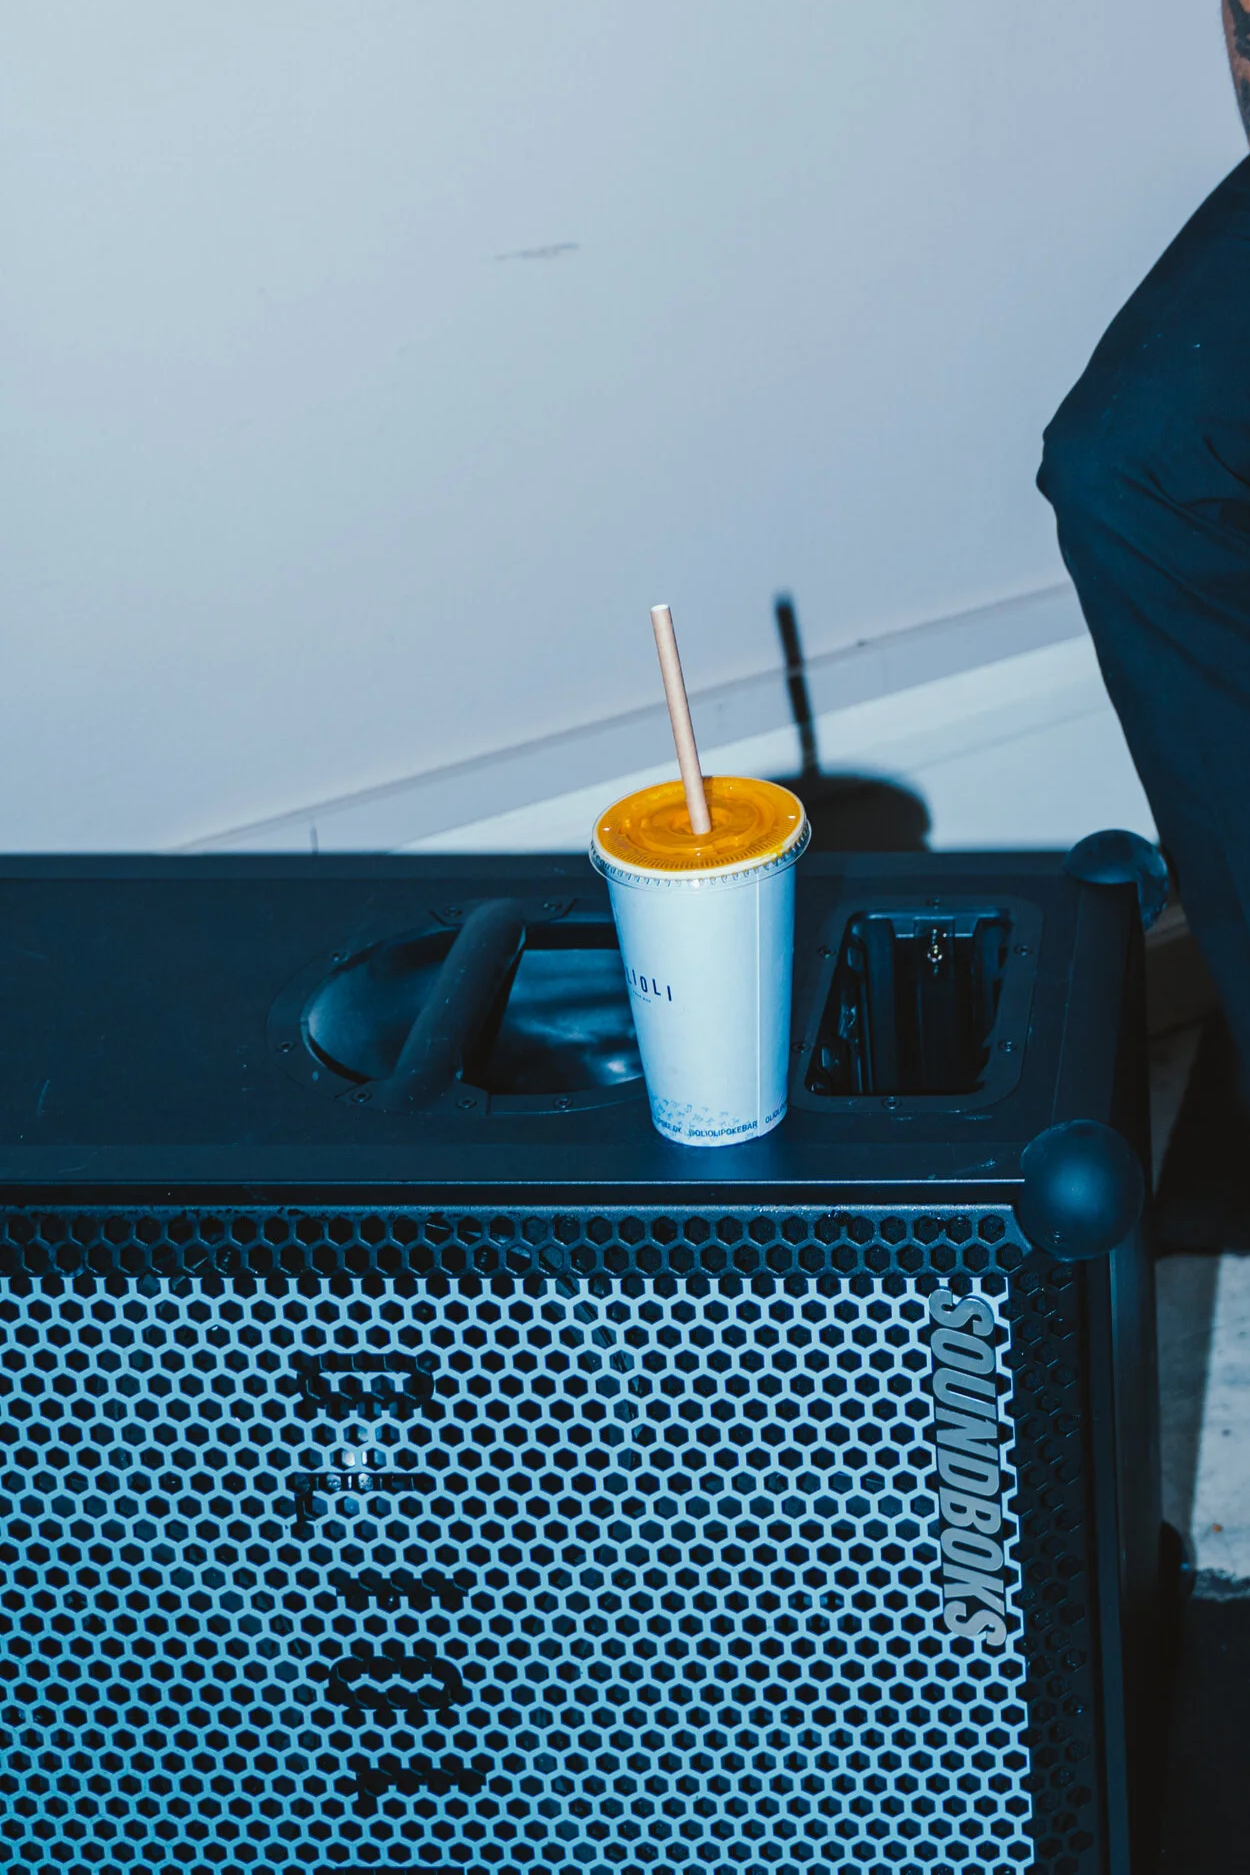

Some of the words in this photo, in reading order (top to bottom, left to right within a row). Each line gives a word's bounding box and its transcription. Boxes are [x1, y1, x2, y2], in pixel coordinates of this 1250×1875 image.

[626, 966, 672, 1002] LIOLI
[294, 1351, 488, 1875] OLIOL
[928, 1285, 1007, 1646] SOUNDBOKS
